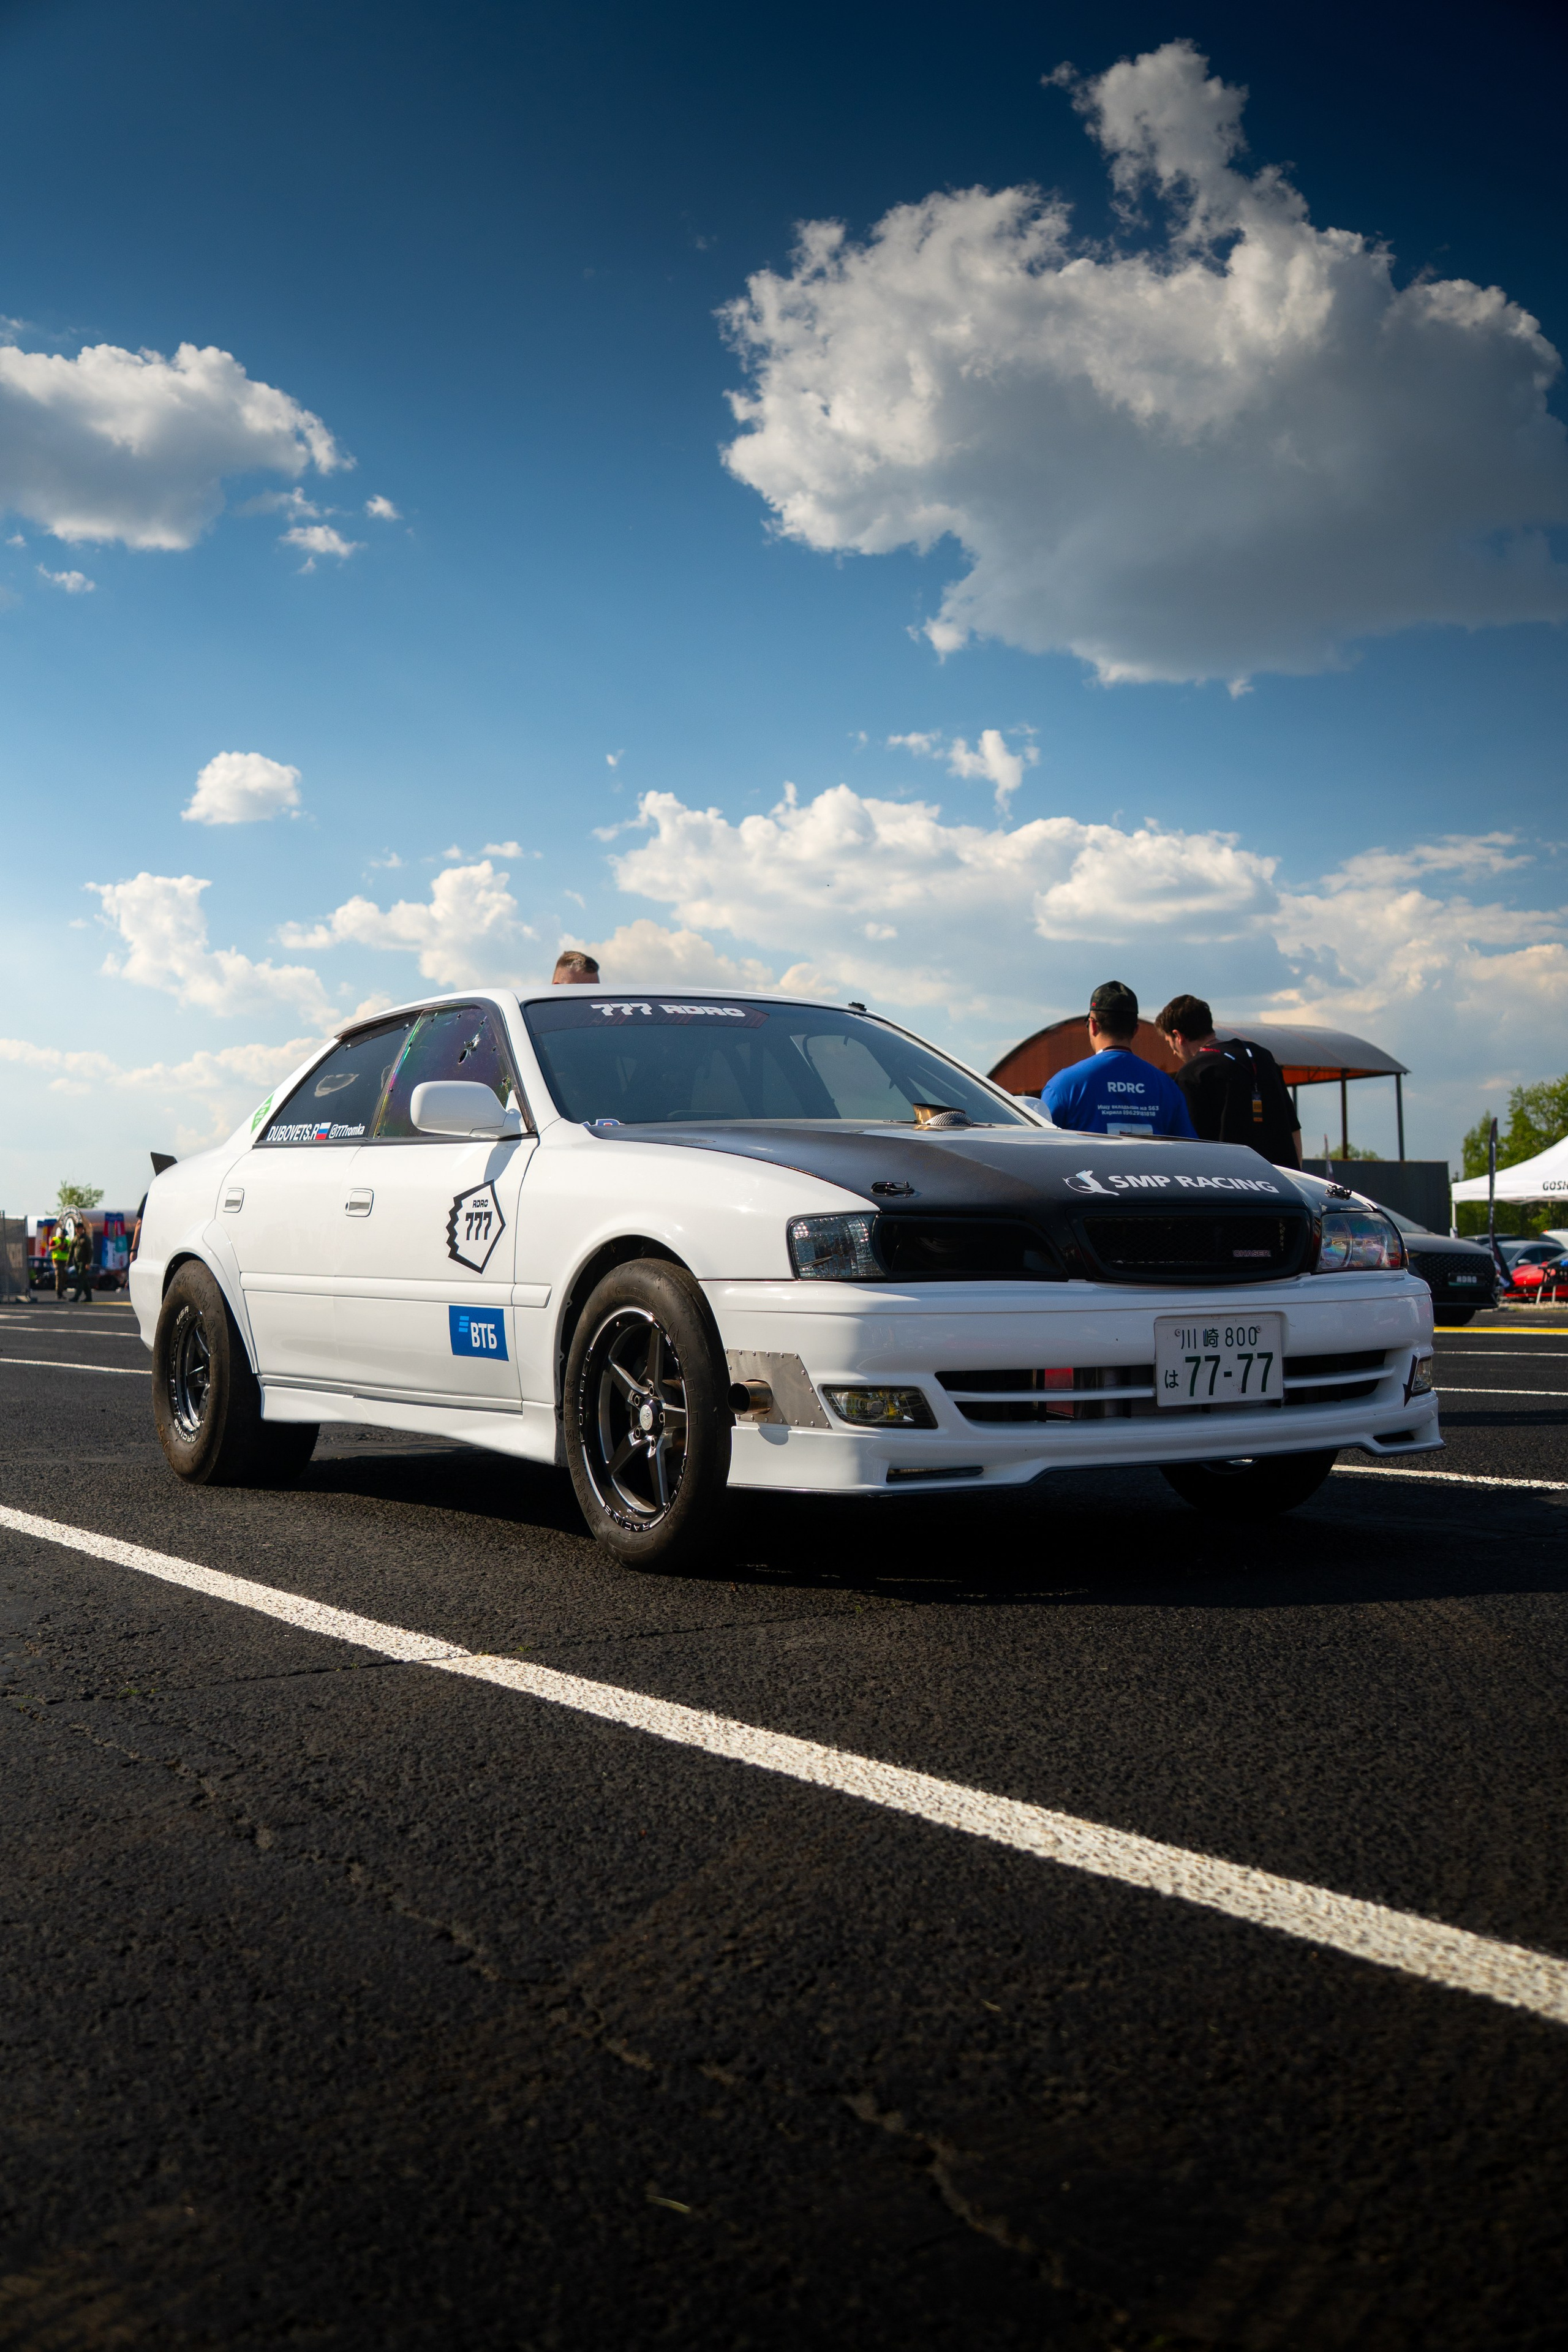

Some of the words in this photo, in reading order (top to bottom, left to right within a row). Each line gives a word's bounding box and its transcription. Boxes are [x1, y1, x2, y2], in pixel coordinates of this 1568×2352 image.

[590, 1003, 652, 1016] 777
[658, 1005, 746, 1017] RDRC
[1107, 1082, 1145, 1094] RDRC
[266, 1123, 320, 1142] DUBOVETS.R
[328, 1123, 365, 1139] @777romka
[1108, 1175, 1170, 1188] SMP
[1174, 1175, 1280, 1193] RACING
[472, 1199, 489, 1208] RDRC
[465, 1210, 493, 1241] 777
[470, 1322, 498, 1349] ВТБ
[1181, 1328, 1219, 1349] 川崎
[1225, 1326, 1257, 1347] 800
[1164, 1369, 1179, 1389] は
[1185, 1351, 1274, 1397] 77-77
[578, 1349, 592, 1443] FORGED
[664, 1457, 687, 1513] WELD
